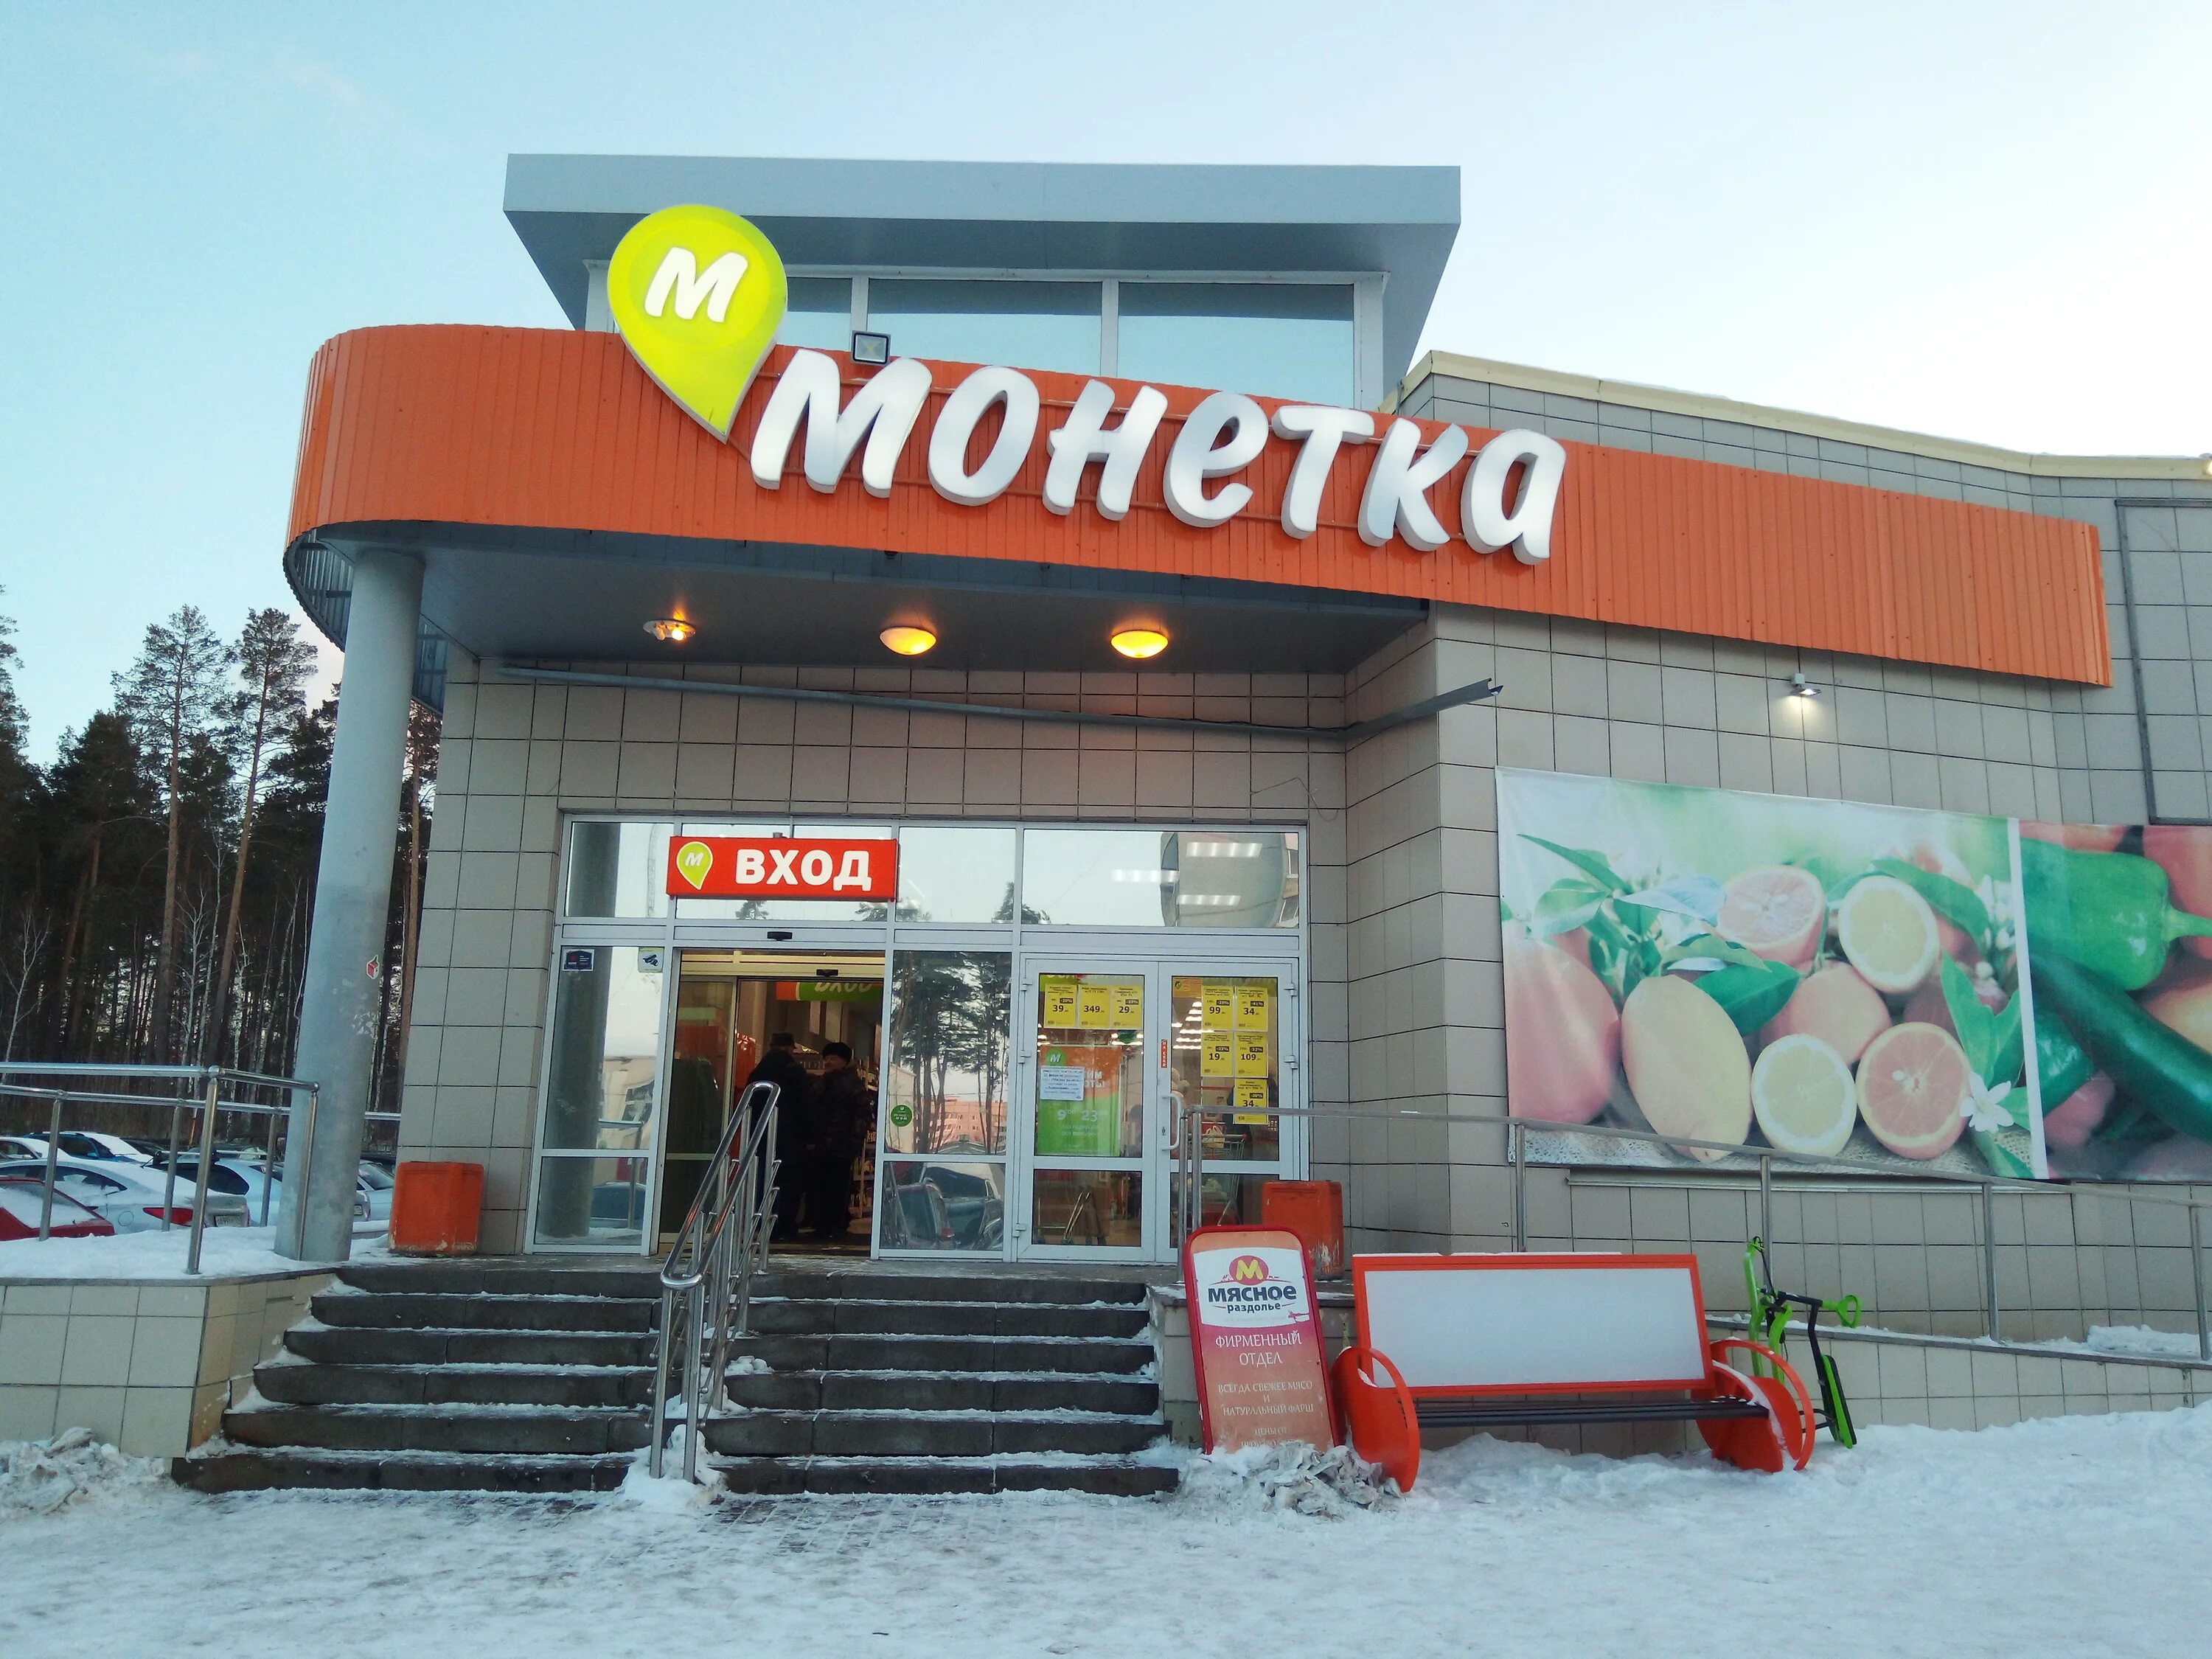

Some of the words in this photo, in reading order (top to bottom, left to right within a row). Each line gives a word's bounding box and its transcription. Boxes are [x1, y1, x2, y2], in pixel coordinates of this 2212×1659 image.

[734, 849, 873, 891] ВХОД
[1053, 1004, 1064, 1012] 39
[1083, 1005, 1100, 1013] 349
[1119, 1006, 1130, 1014] 29
[1227, 1302, 1281, 1314] раздолье
[1215, 1329, 1302, 1349] ФИРМЕННЫЙ
[1239, 1352, 1284, 1368] ОТДЕЛ
[1218, 1383, 1251, 1394] ВСЕГДА
[1253, 1382, 1287, 1393] СВЕЖЕЕ
[1288, 1380, 1313, 1391] МЯСО
[1263, 1394, 1270, 1403] И
[1223, 1404, 1287, 1416] НАТУРАЛЬНЫЙ
[1288, 1403, 1314, 1414] ФАРШ
[1254, 1427, 1277, 1438] ЦЕНЫ
[1277, 1427, 1288, 1436] ОТ
